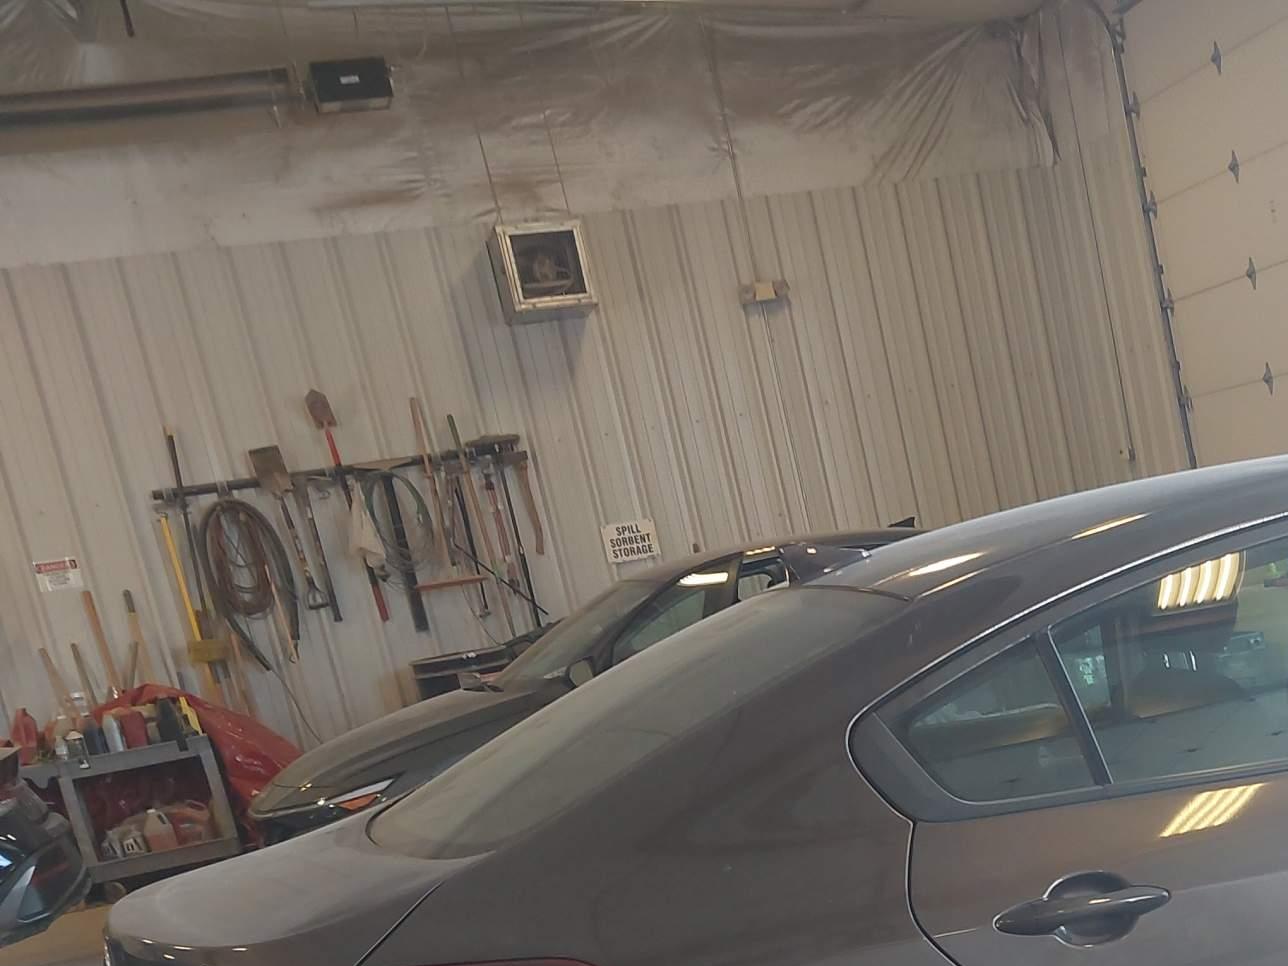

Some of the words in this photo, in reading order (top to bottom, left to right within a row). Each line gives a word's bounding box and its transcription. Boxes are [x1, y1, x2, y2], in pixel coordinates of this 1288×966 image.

[615, 523, 641, 536] SPILL
[609, 533, 651, 549] SORBENT
[612, 544, 654, 559] STORAGE
